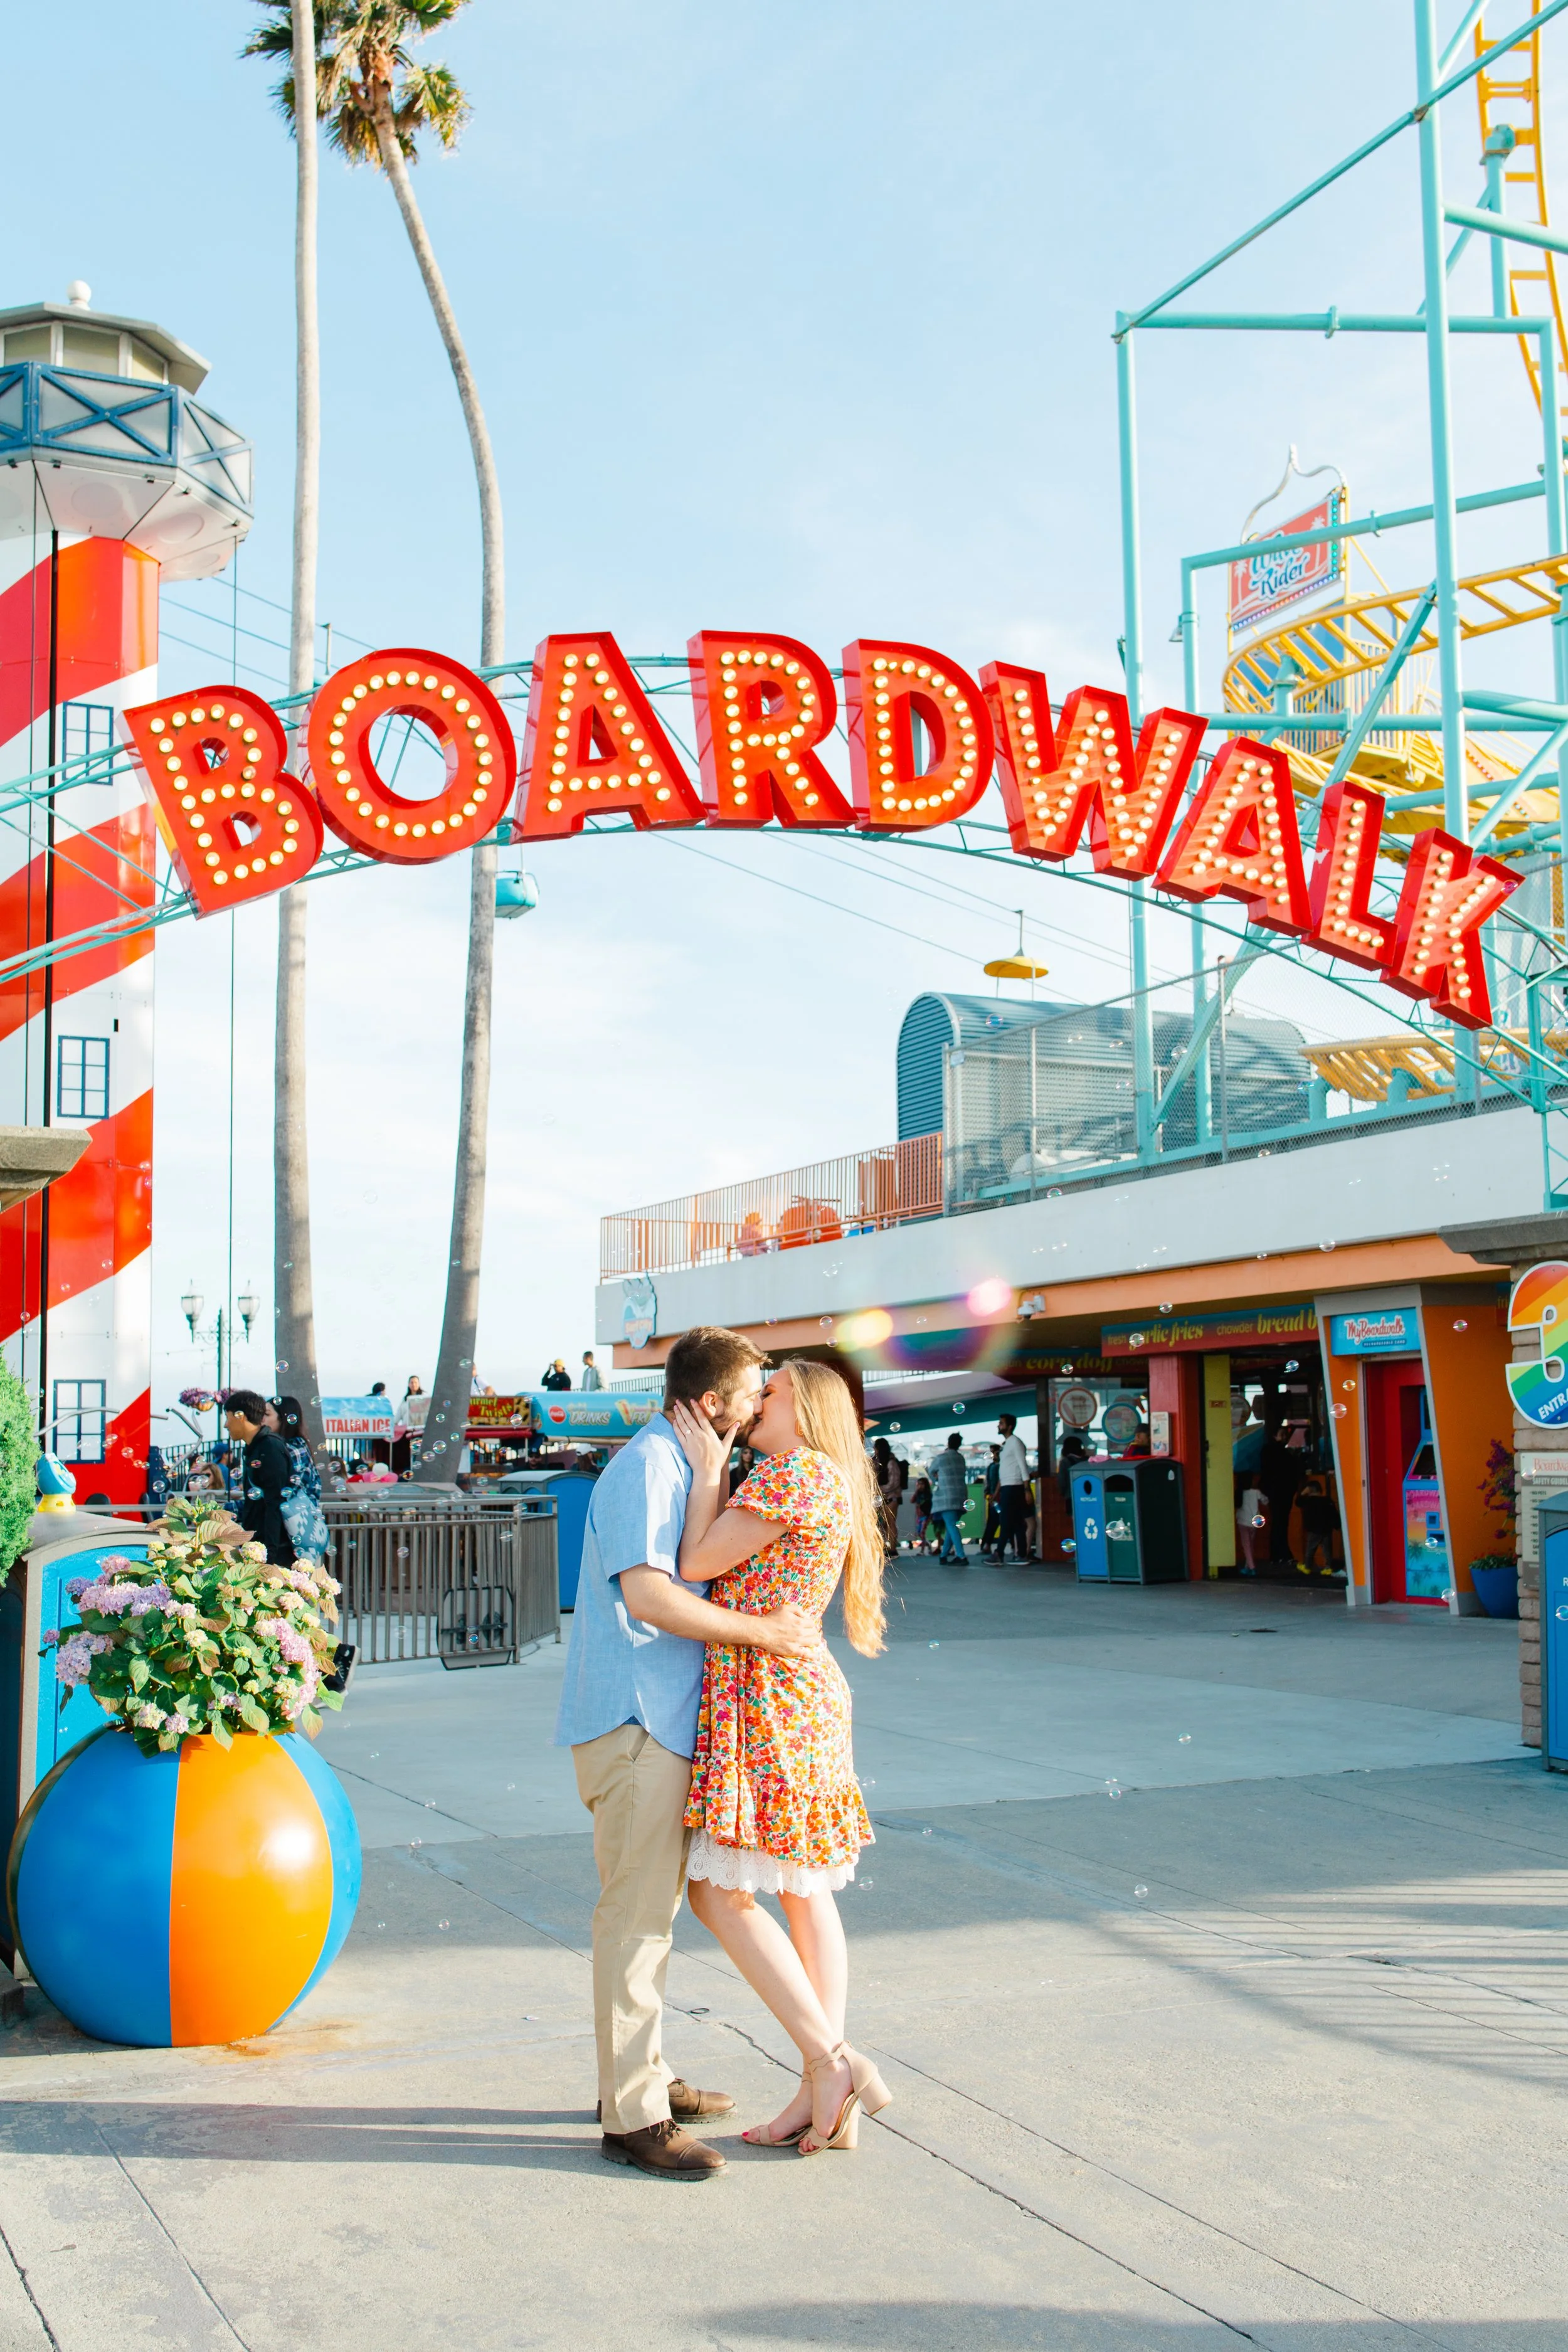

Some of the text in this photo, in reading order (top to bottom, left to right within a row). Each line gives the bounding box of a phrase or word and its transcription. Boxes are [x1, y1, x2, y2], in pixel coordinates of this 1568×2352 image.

[1252, 554, 1308, 596] Rider
[119, 630, 1525, 1030] BOARDWALK
[1108, 1333, 1126, 1345] fresh
[1129, 1323, 1168, 1351] arlic
[1169, 1320, 1204, 1347] fries
[1217, 1322, 1253, 1335] chowder
[1257, 1308, 1305, 1334] bread
[1076, 1352, 1113, 1372] dog
[326, 1418, 391, 1433] ITALIAN ICE
[569, 1411, 612, 1426] DRINKS
